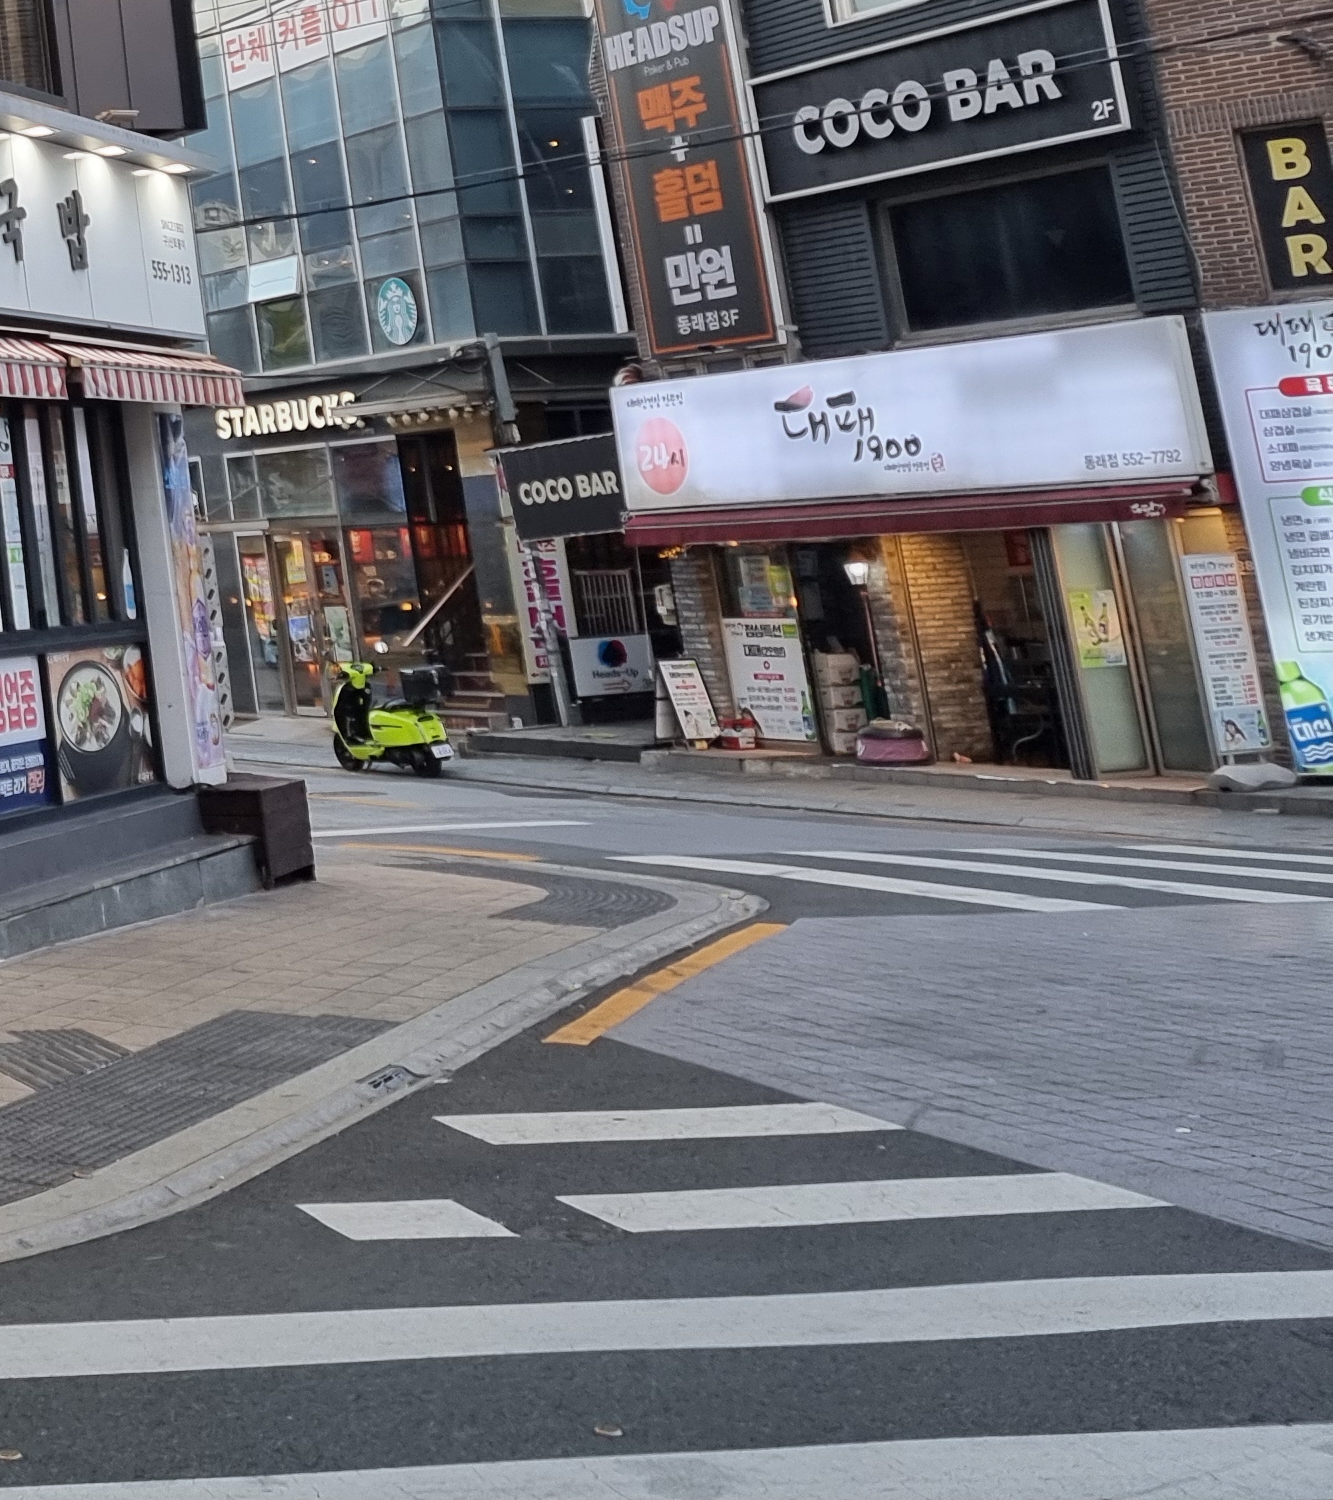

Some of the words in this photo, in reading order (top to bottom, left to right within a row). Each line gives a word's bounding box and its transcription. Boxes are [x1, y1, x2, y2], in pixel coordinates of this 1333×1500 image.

[603, 4, 722, 73] HEADSUP
[792, 79, 933, 155] COCO
[942, 47, 1065, 123] BAR
[1090, 97, 1115, 122] 2F
[151, 259, 192, 285] 555-1313
[662, 243, 738, 307] 만원
[215, 391, 357, 441] STARBUCKS
[1083, 450, 1118, 470] 동래점
[1120, 447, 1183, 467] 552-7792
[519, 476, 574, 506] COCO
[575, 470, 620, 499] BAR
